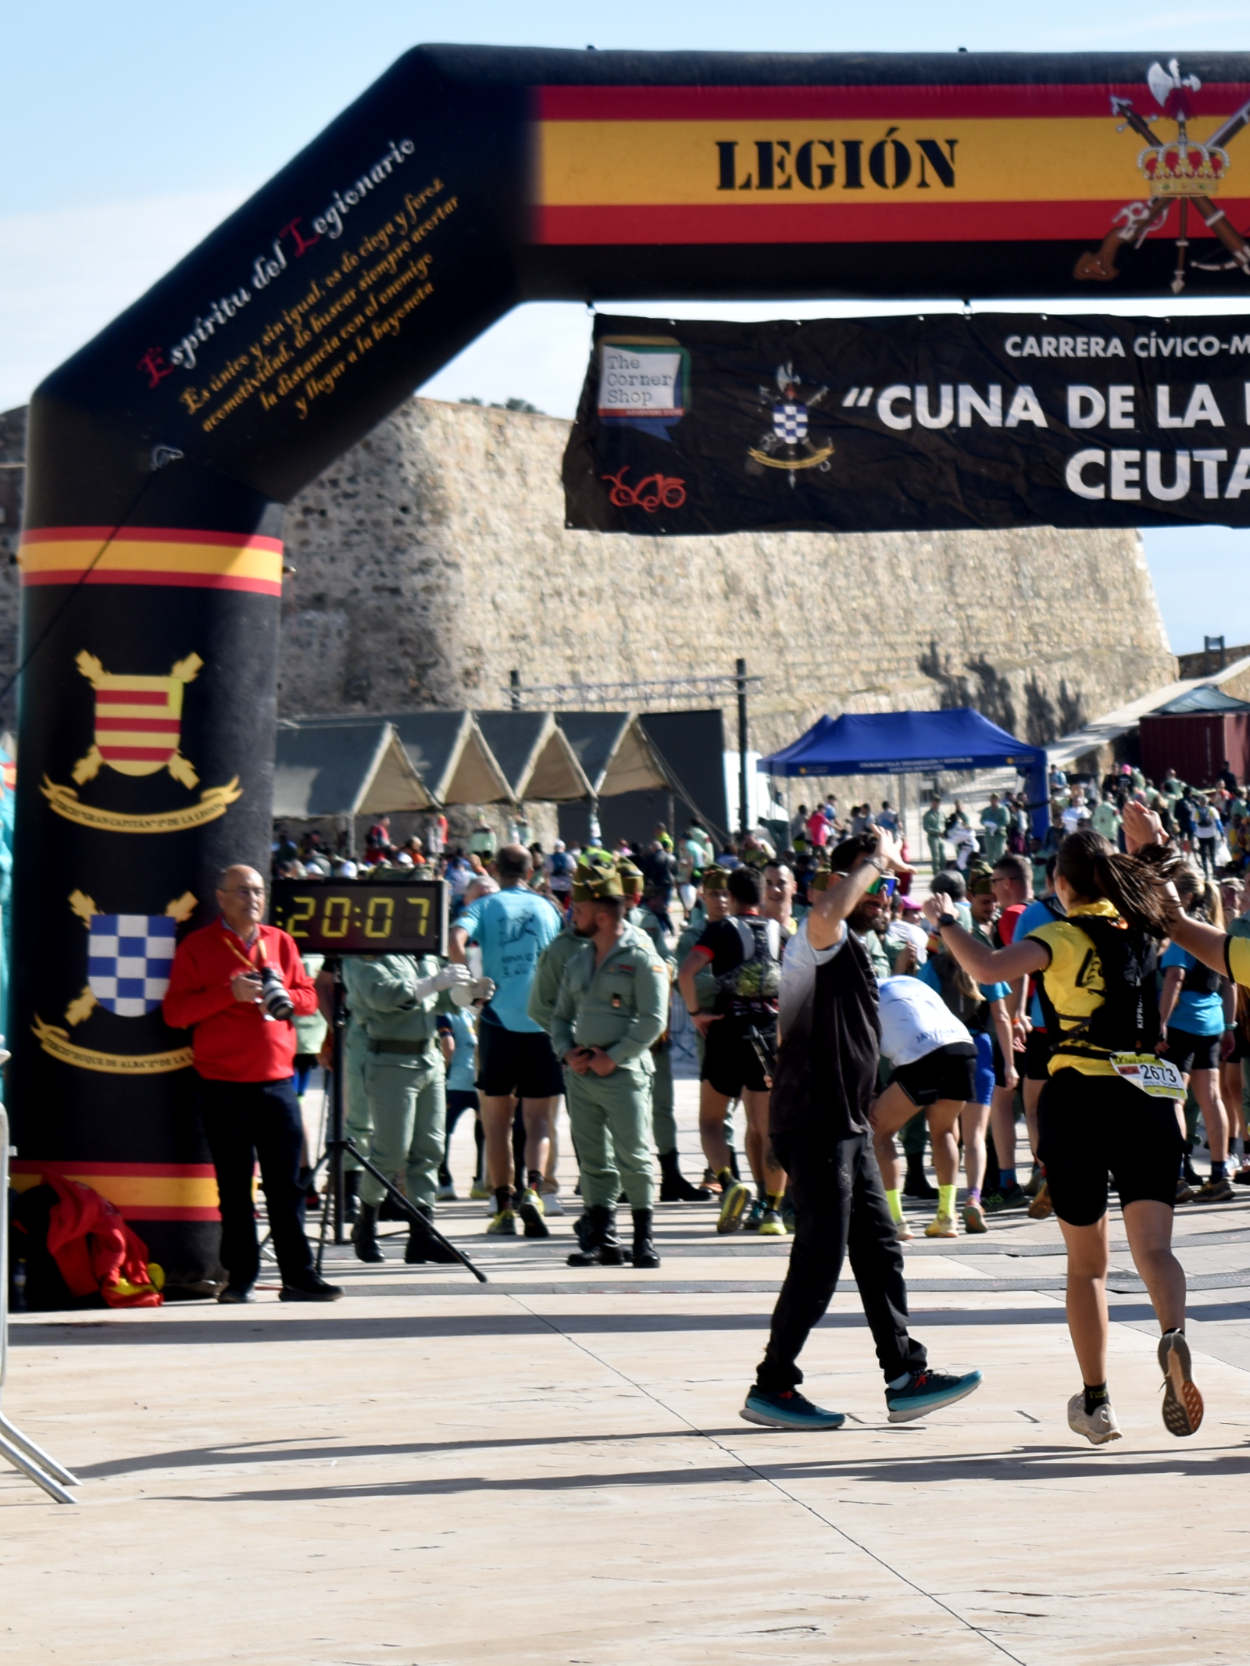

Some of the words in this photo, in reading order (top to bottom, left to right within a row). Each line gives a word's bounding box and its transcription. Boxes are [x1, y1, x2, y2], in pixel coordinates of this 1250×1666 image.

[714, 126, 960, 192] LEGIÓN
[251, 240, 287, 289] del
[279, 138, 415, 257] Legionario
[249, 343, 264, 364] y
[262, 322, 285, 345] sin
[325, 270, 341, 287] es
[341, 253, 358, 273] de
[358, 222, 395, 256] ciega
[394, 212, 408, 235] y
[401, 178, 444, 223] feroz
[293, 325, 311, 348] de
[309, 288, 356, 333] buscar
[358, 240, 410, 296] siempre
[411, 196, 457, 243] acortar
[259, 392, 278, 410] la
[276, 335, 340, 396] distancia
[339, 313, 365, 339] con
[364, 293, 378, 317] el
[378, 253, 432, 304] enemigo
[294, 397, 308, 419] y
[304, 360, 345, 399] llegar
[347, 350, 357, 363] a
[355, 336, 373, 353] la
[370, 276, 434, 340] bayoneta
[1005, 335, 1125, 359] CARRERA
[606, 355, 640, 370] The
[607, 372, 673, 387] Corner
[607, 388, 653, 407] Shop
[1067, 384, 1139, 430] DE
[1153, 383, 1226, 429] LA
[166, 818, 179, 828] DE
[181, 814, 194, 826] LA
[105, 1058, 117, 1068] DE
[159, 1057, 171, 1067] DE
[174, 1054, 186, 1065] LA
[1140, 1064, 1177, 1083] 2673
